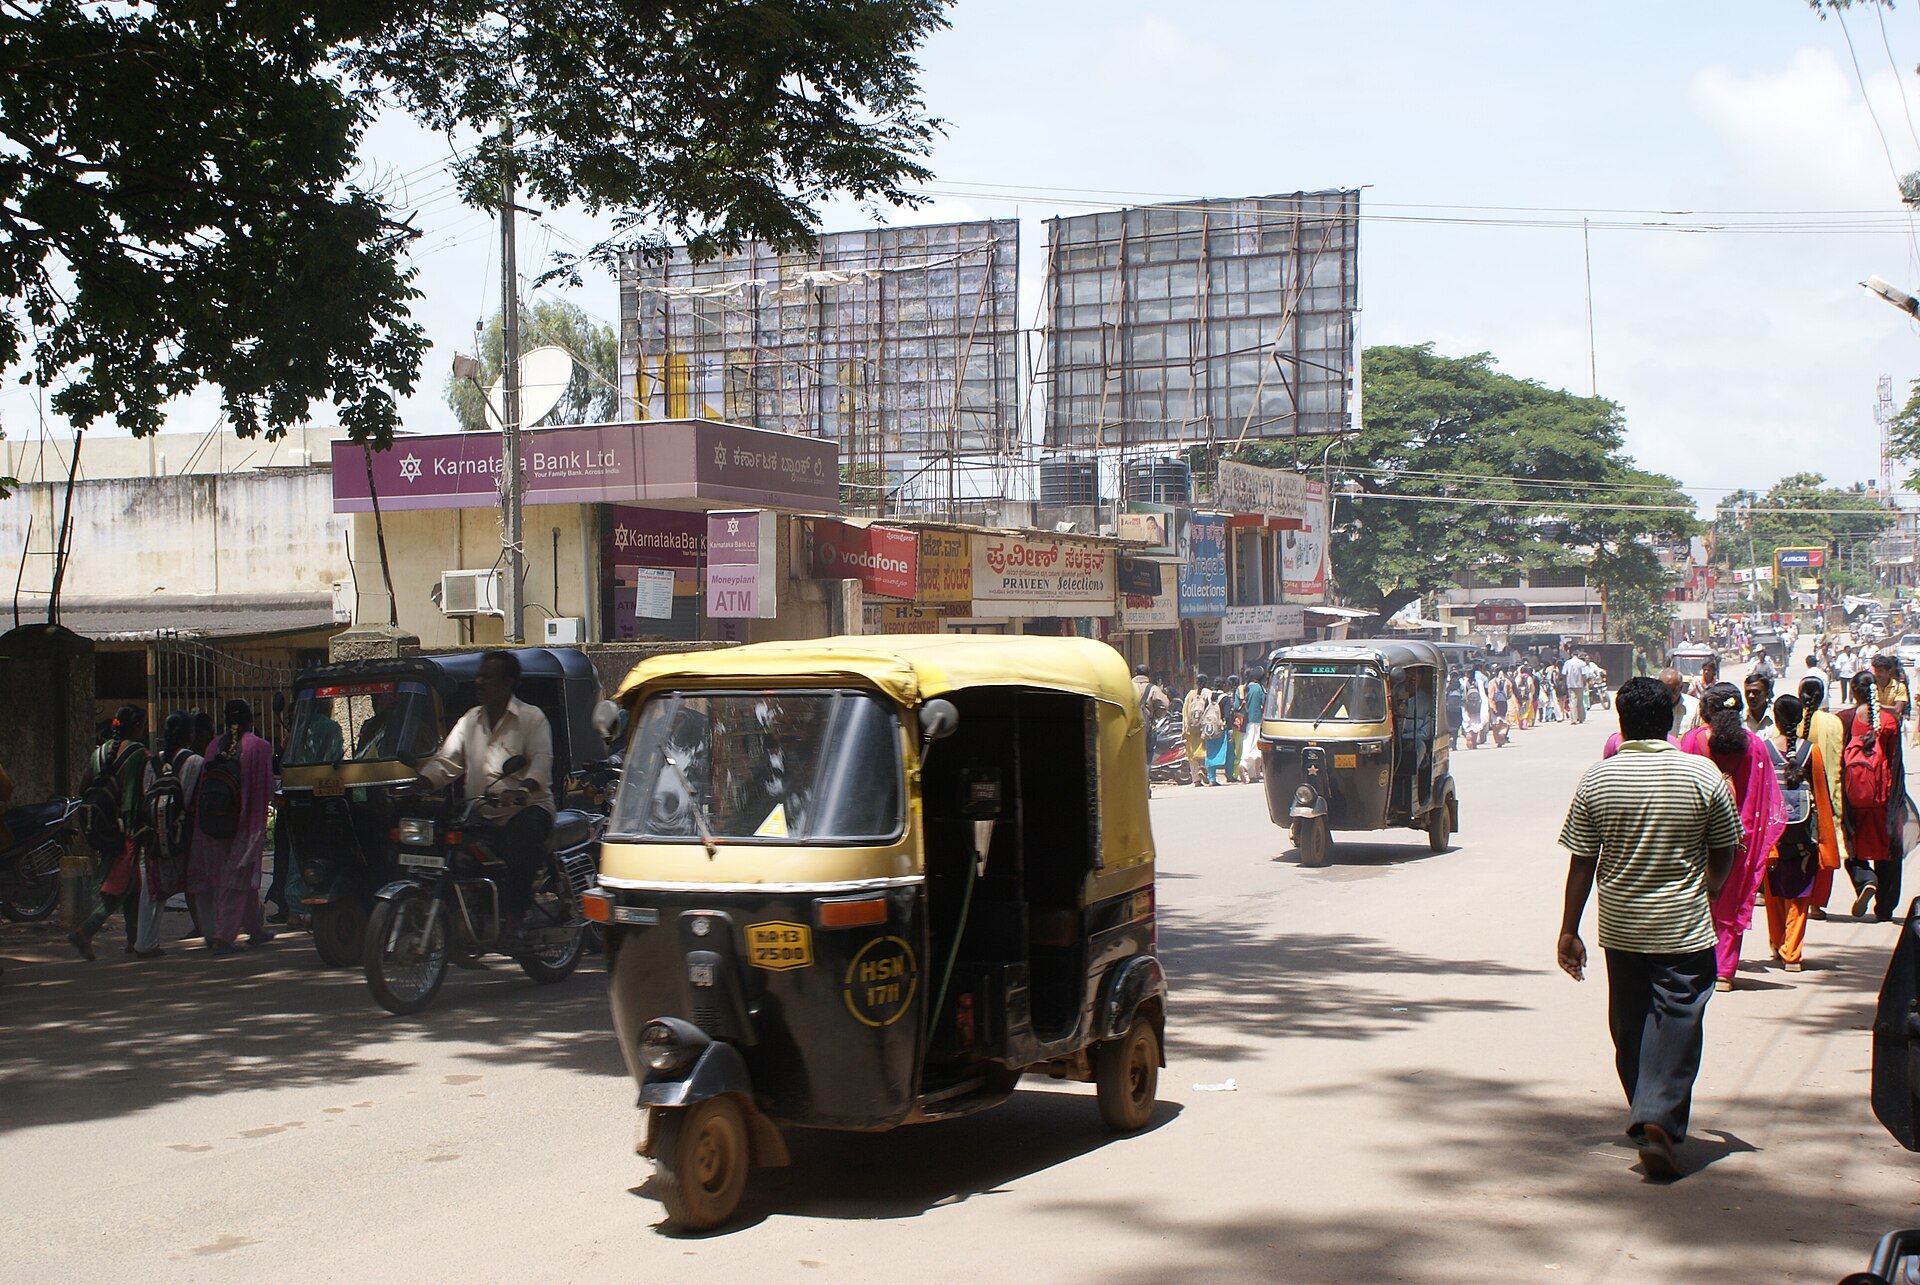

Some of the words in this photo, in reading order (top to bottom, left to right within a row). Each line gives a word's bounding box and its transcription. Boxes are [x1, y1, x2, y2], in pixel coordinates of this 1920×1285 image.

[434, 456, 527, 475] Karnataa
[533, 451, 580, 471] Bank
[586, 449, 621, 468] Ltd.
[548, 470, 566, 478] Family
[629, 529, 680, 548] Karnataka
[734, 540, 747, 548] Bank
[841, 551, 908, 574] vodafone
[986, 543, 1058, 574] ಪ್ರವೀಣ್
[711, 575, 755, 586] Moneyplant
[1002, 577, 1050, 590] PRAVEEN
[1057, 576, 1104, 591] Selections
[1181, 584, 1226, 598] Collections
[715, 591, 751, 611] ATM
[756, 947, 804, 961] 7500
